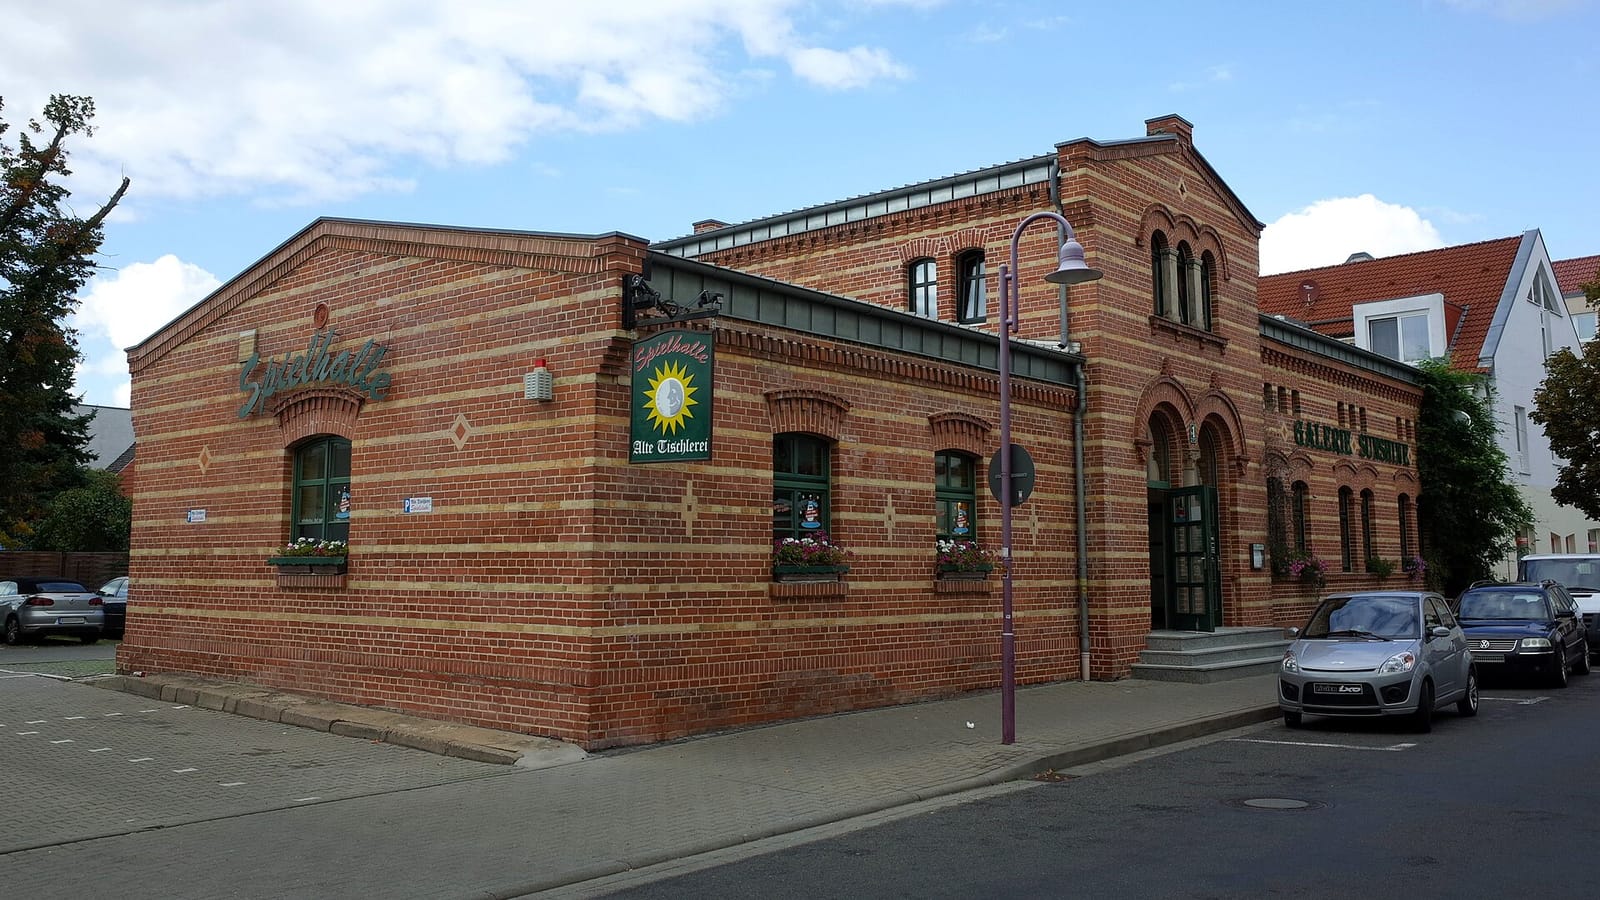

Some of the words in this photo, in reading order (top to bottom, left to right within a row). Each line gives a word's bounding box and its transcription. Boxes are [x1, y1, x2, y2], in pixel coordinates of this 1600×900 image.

[635, 335, 708, 371] Spielhalle
[238, 329, 391, 417] Spielhalle
[632, 440, 654, 455] Alte
[657, 438, 708, 455] Tischlerei
[1294, 420, 1352, 455] GALERIE
